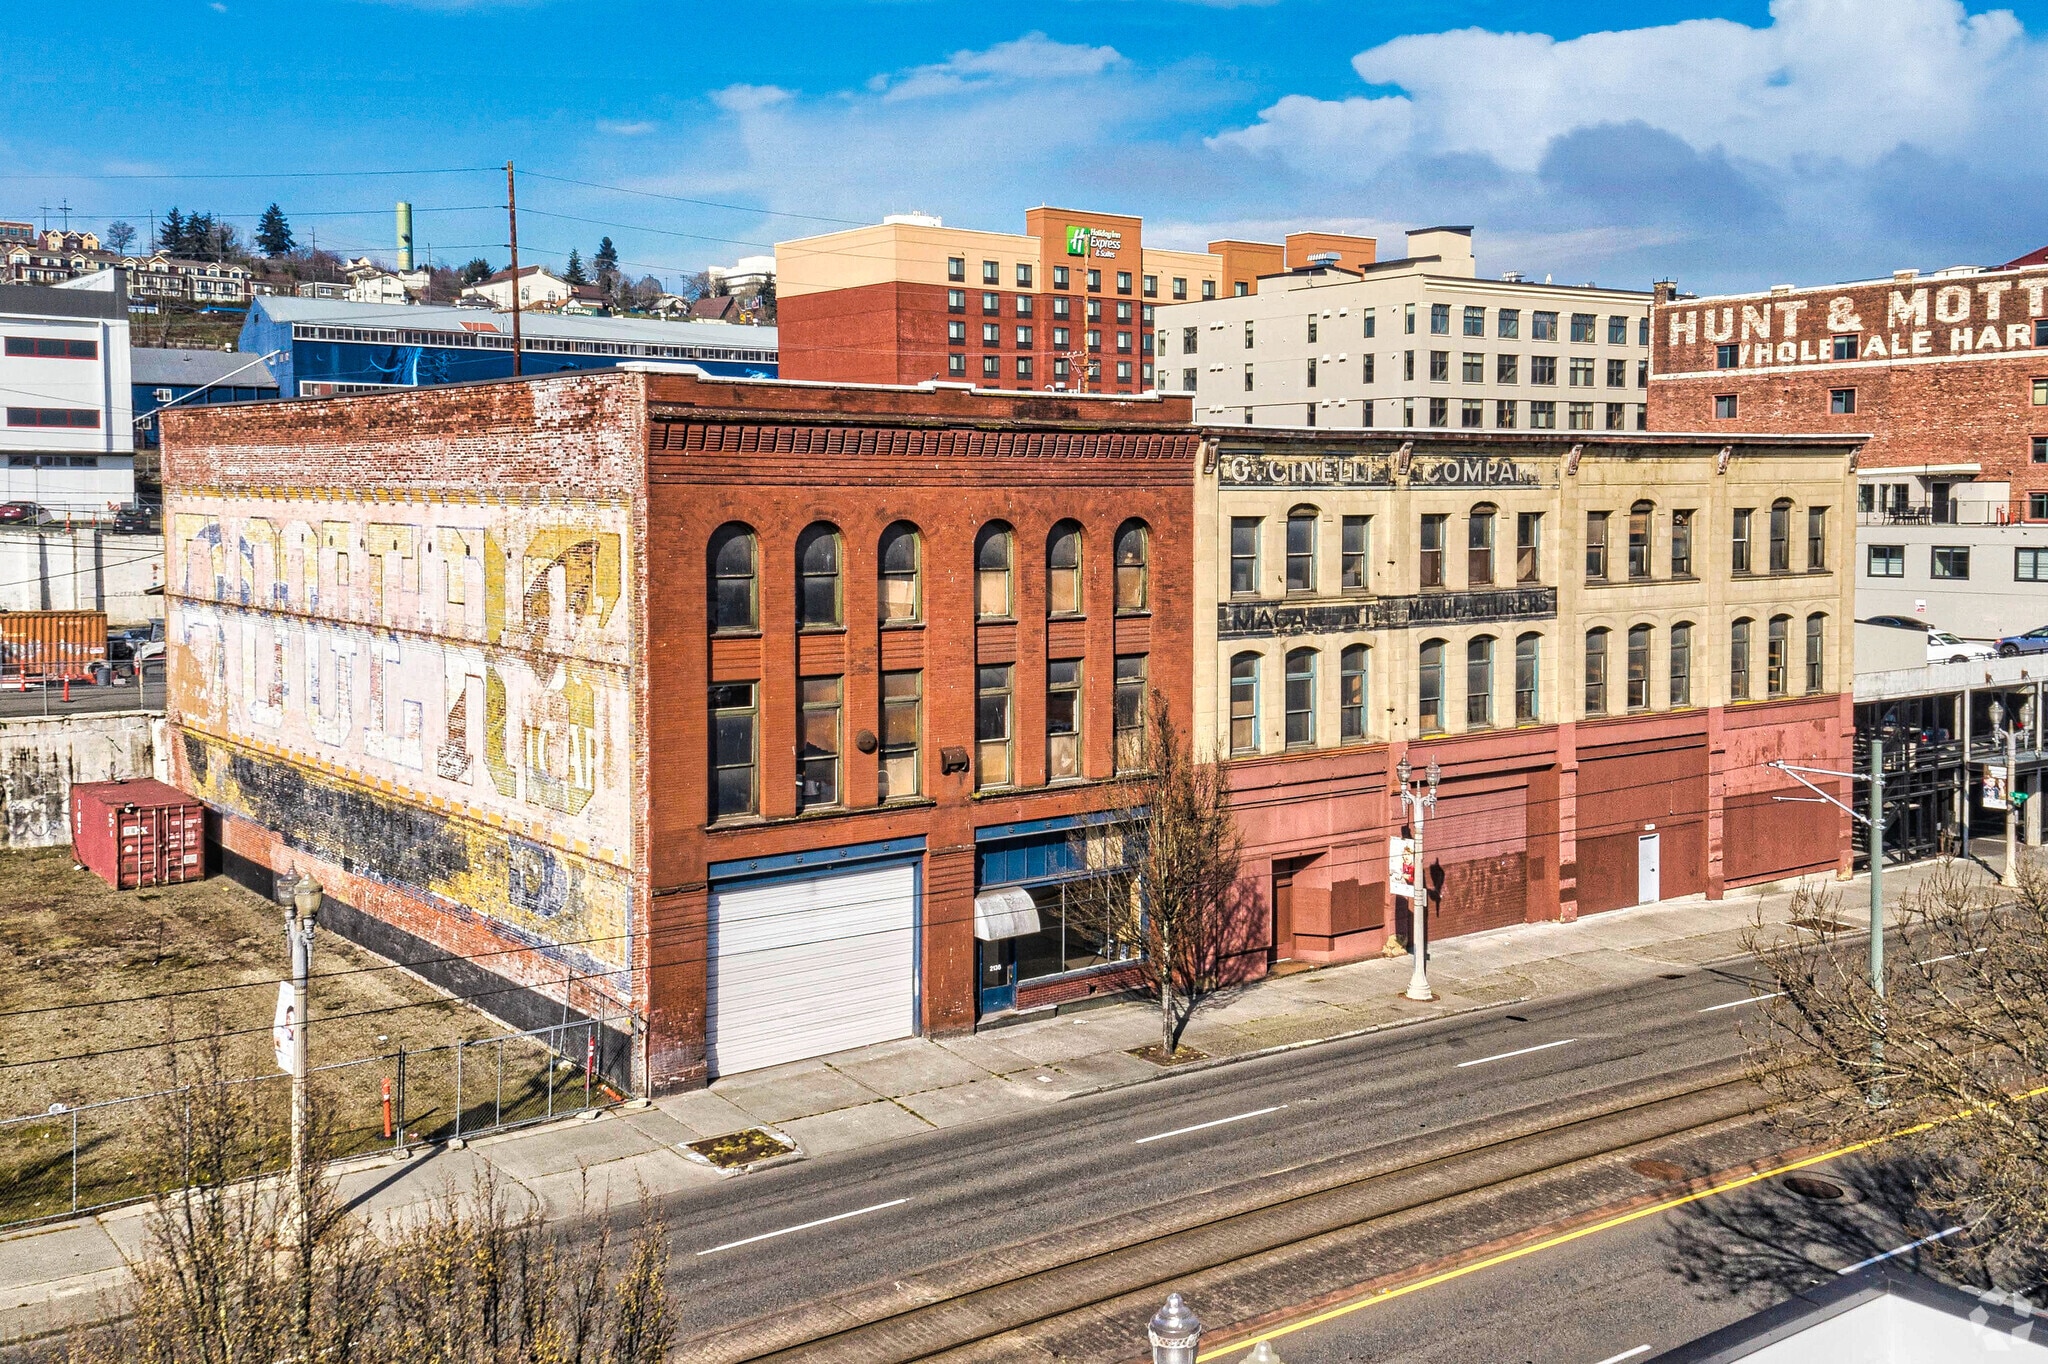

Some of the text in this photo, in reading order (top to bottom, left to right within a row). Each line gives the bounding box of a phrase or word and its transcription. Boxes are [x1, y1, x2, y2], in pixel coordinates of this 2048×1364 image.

[1090, 236, 1121, 250] Express
[1101, 250, 1116, 258] Suites
[1669, 277, 2048, 347] HUNT & MOTT
